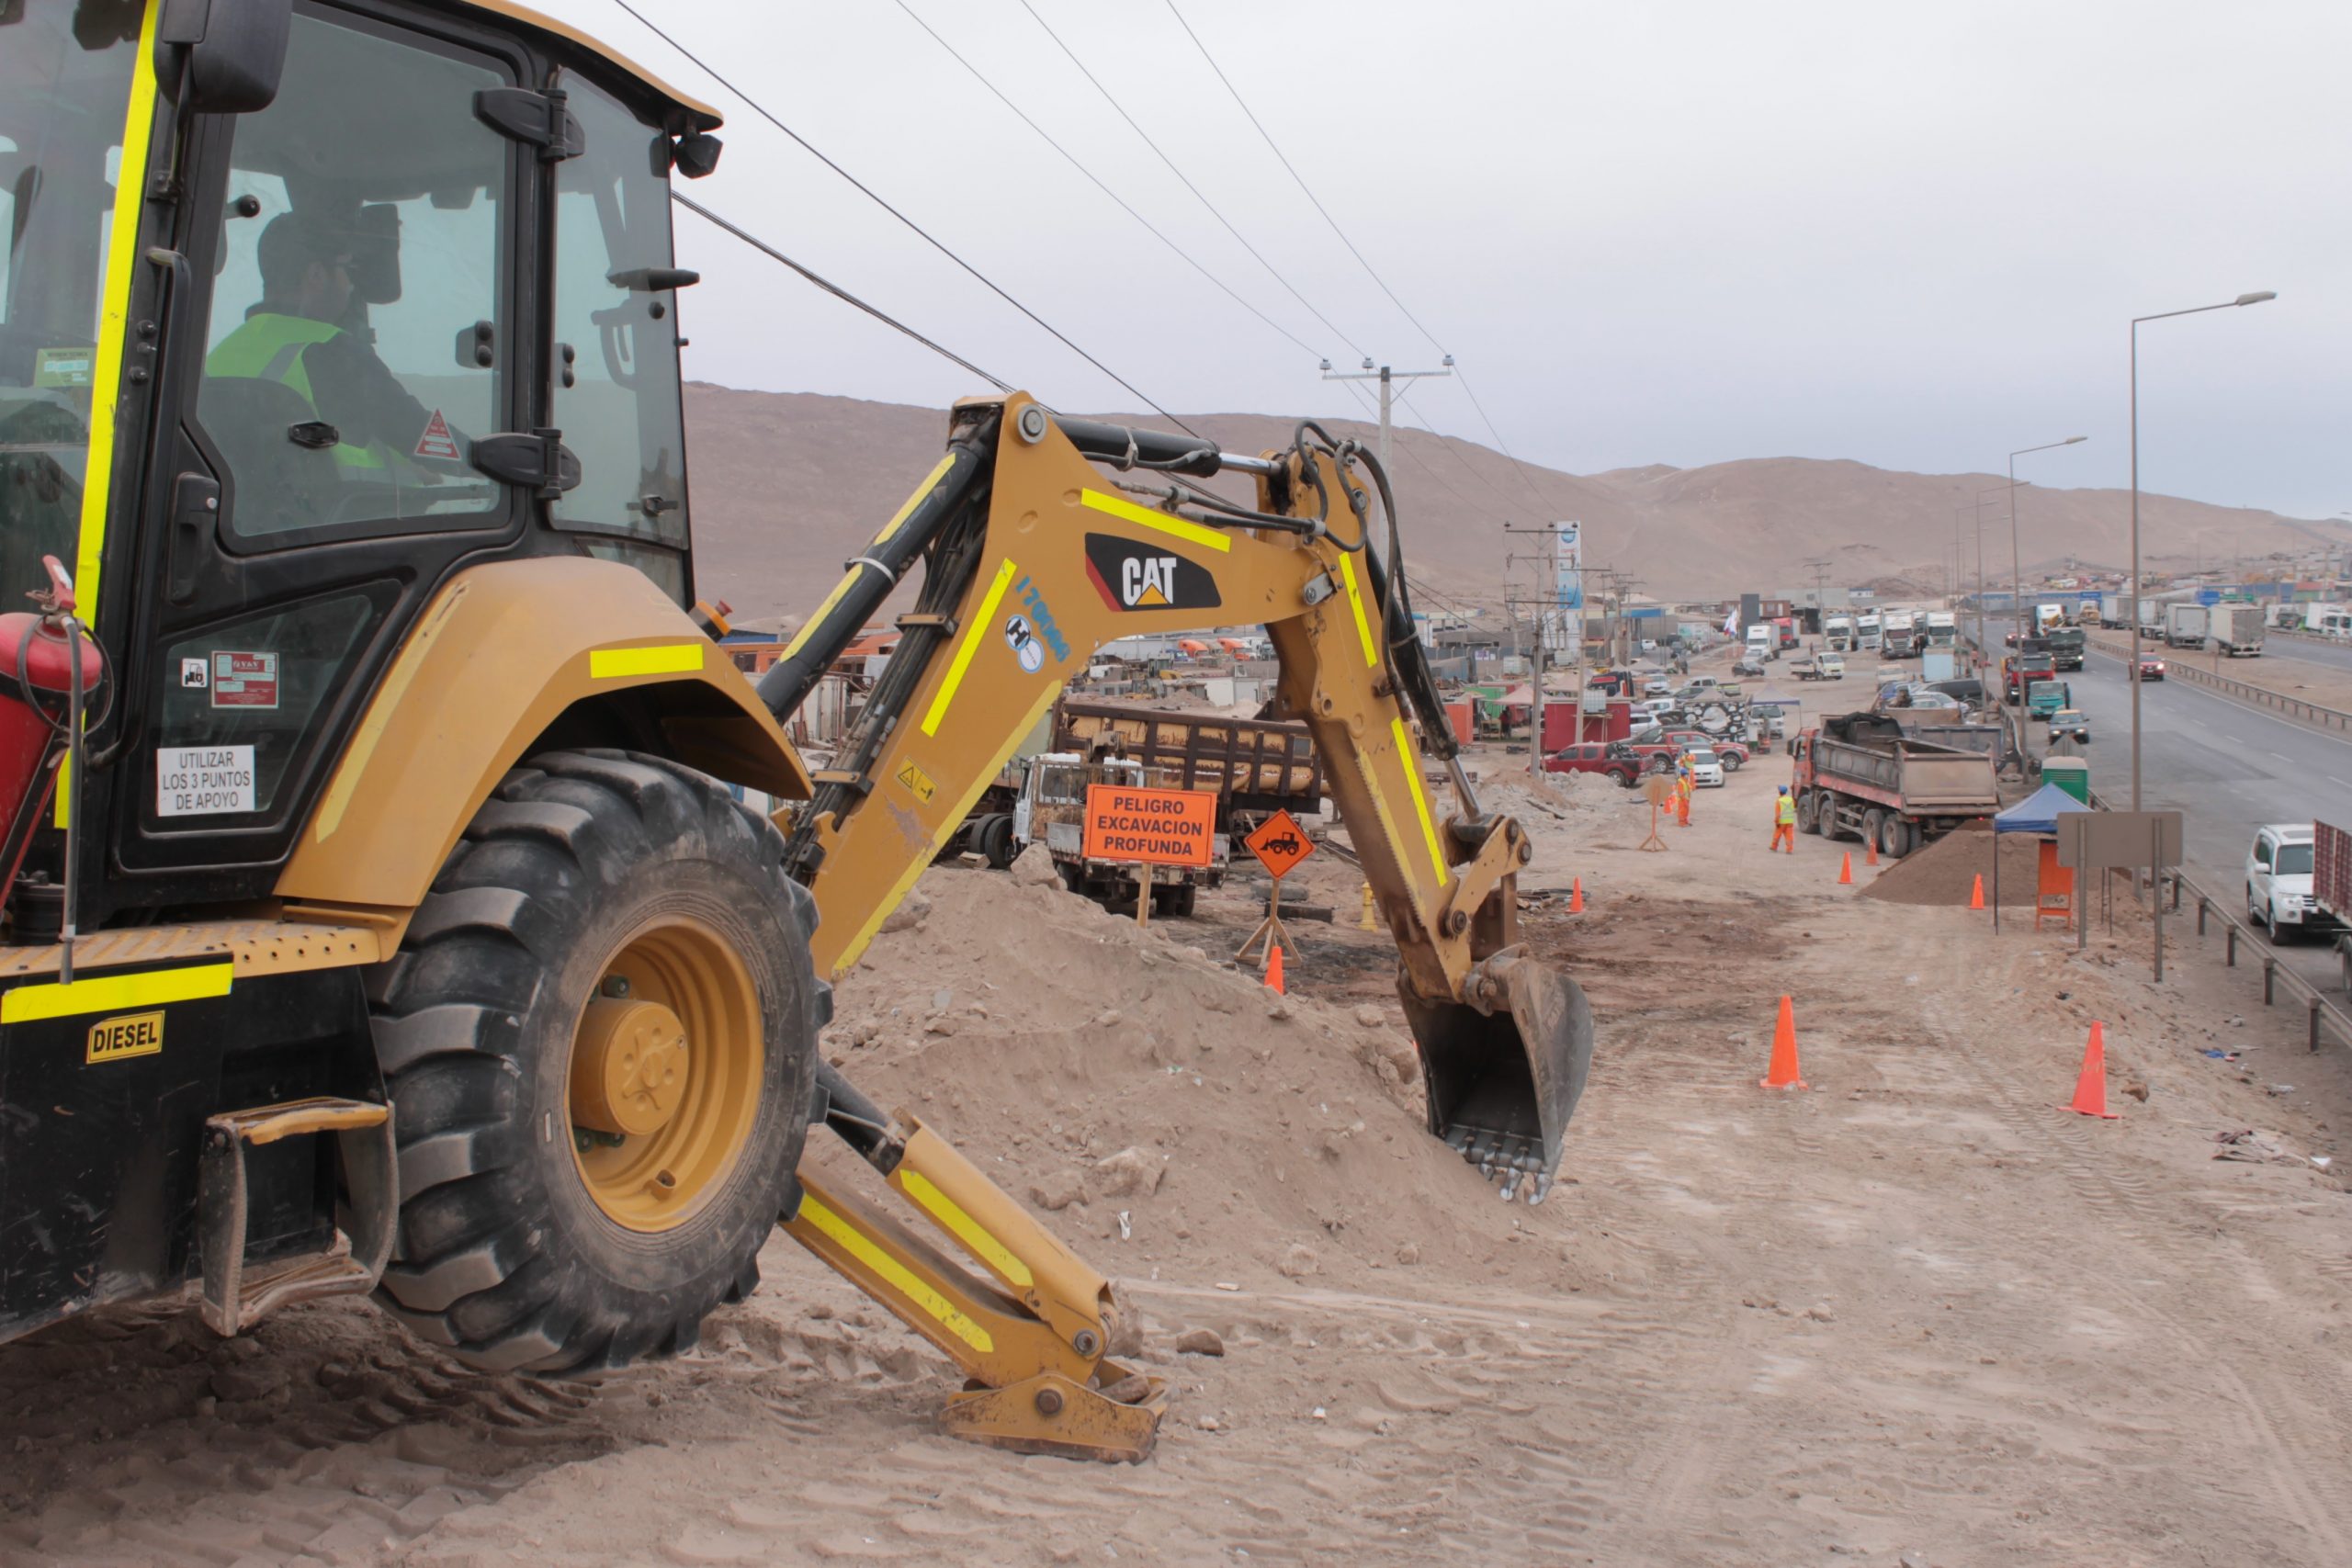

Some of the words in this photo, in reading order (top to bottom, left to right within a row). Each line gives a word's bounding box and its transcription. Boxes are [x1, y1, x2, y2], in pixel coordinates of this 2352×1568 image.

[1122, 557, 1177, 606] CAT
[179, 751, 234, 769] UTILIZAR
[163, 773, 188, 790] LOS
[191, 773, 198, 789] 3
[201, 771, 251, 788] PUNTOS
[175, 794, 193, 810] DE
[196, 791, 239, 809] APOYO
[1114, 795, 1184, 815] PELIGRO
[1097, 815, 1203, 836] EXCAVACION
[1103, 836, 1193, 856] PROFUNDA
[93, 1021, 158, 1053] DIESEL
